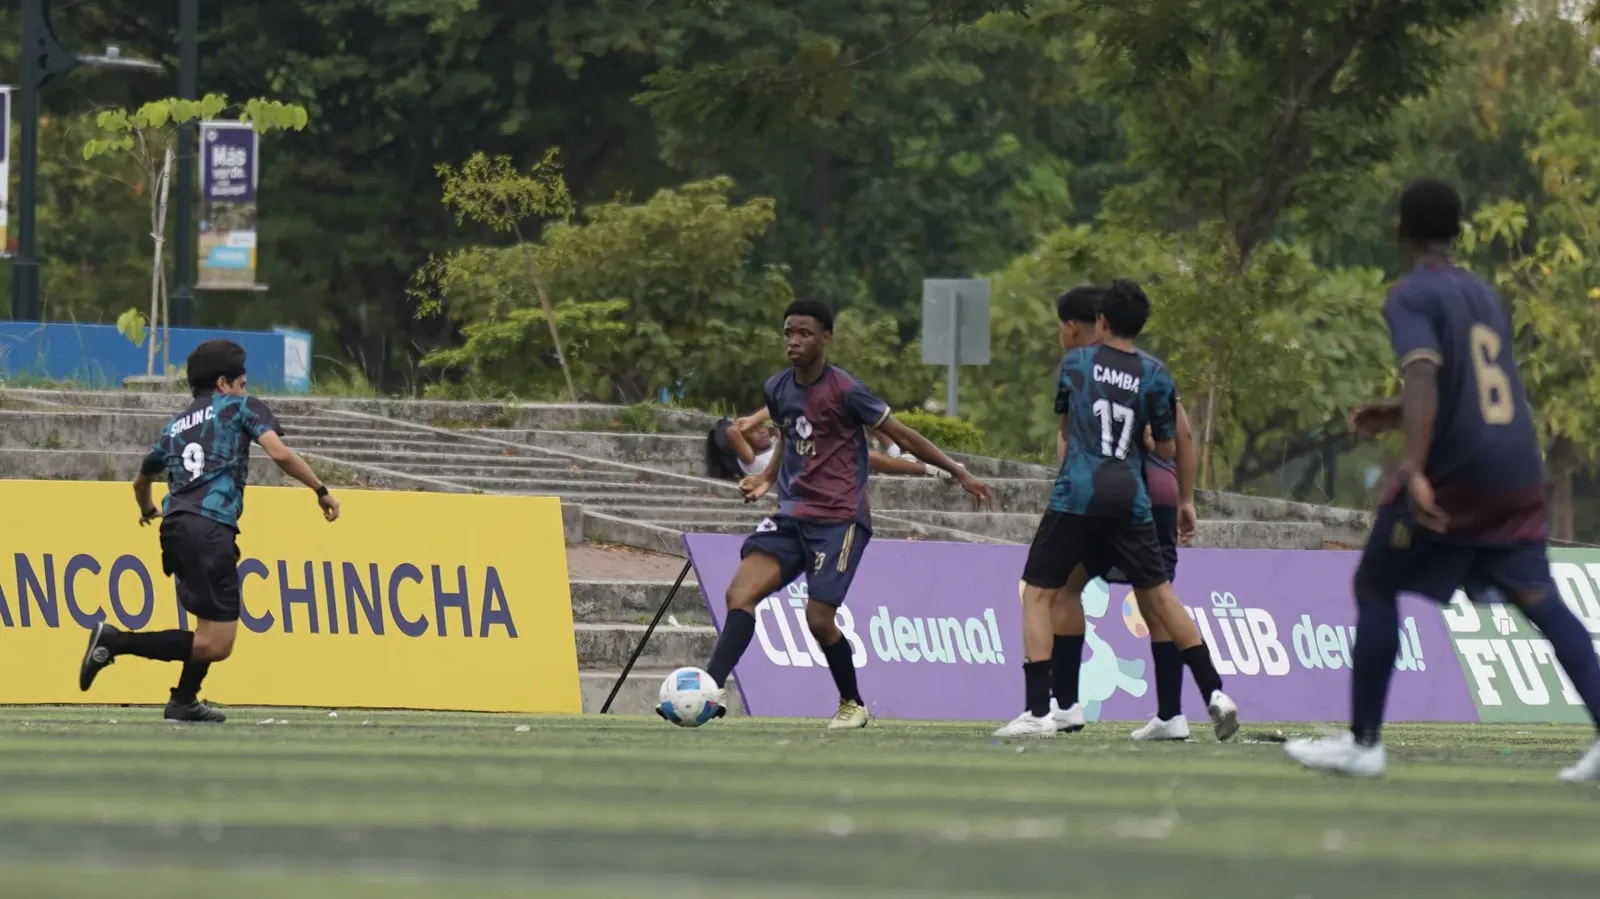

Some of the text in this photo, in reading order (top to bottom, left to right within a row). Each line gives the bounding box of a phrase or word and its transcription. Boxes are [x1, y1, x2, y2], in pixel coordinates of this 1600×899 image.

[1093, 363, 1140, 394] CAMBA
[1469, 322, 1516, 425] 6
[170, 405, 216, 438] STALIN C.
[1093, 398, 1135, 460] 17
[182, 442, 205, 482] 9
[174, 557, 518, 639] CHINCHA
[869, 606, 1005, 665] deuna!
[1183, 605, 1426, 676] LUB deua!
[1455, 638, 1600, 706] FUT
